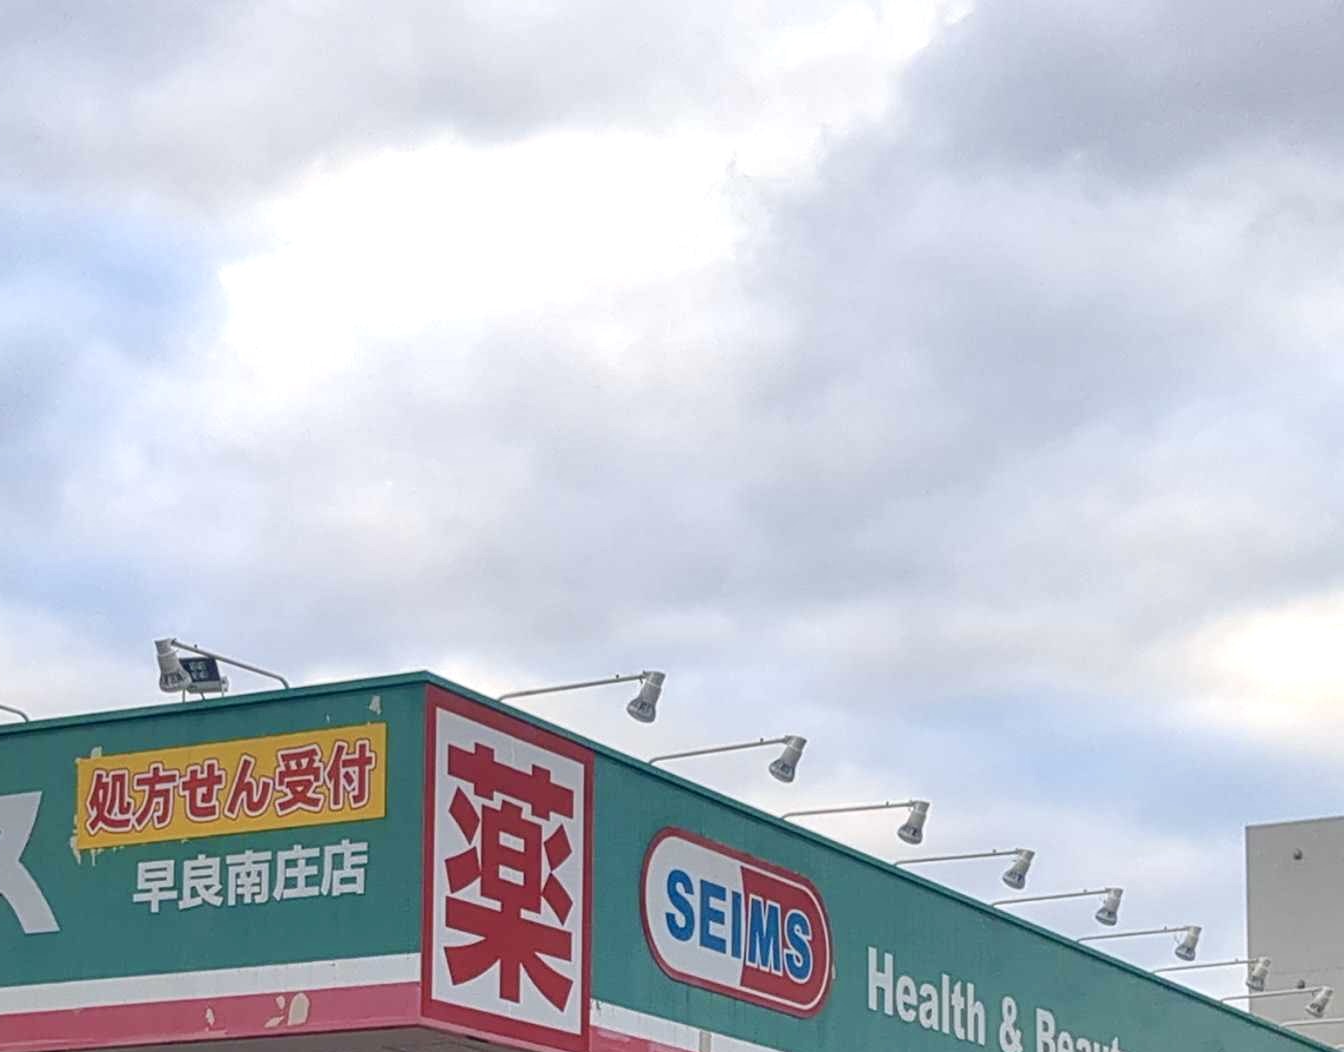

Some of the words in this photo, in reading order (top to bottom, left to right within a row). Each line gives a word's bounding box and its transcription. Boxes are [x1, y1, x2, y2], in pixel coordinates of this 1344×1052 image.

[86, 738, 379, 836] 処方せん受付
[131, 840, 368, 913] 早良南庄店
[443, 741, 575, 1013] 薬
[664, 868, 813, 983] SEIMS
[867, 946, 986, 1046] Health
